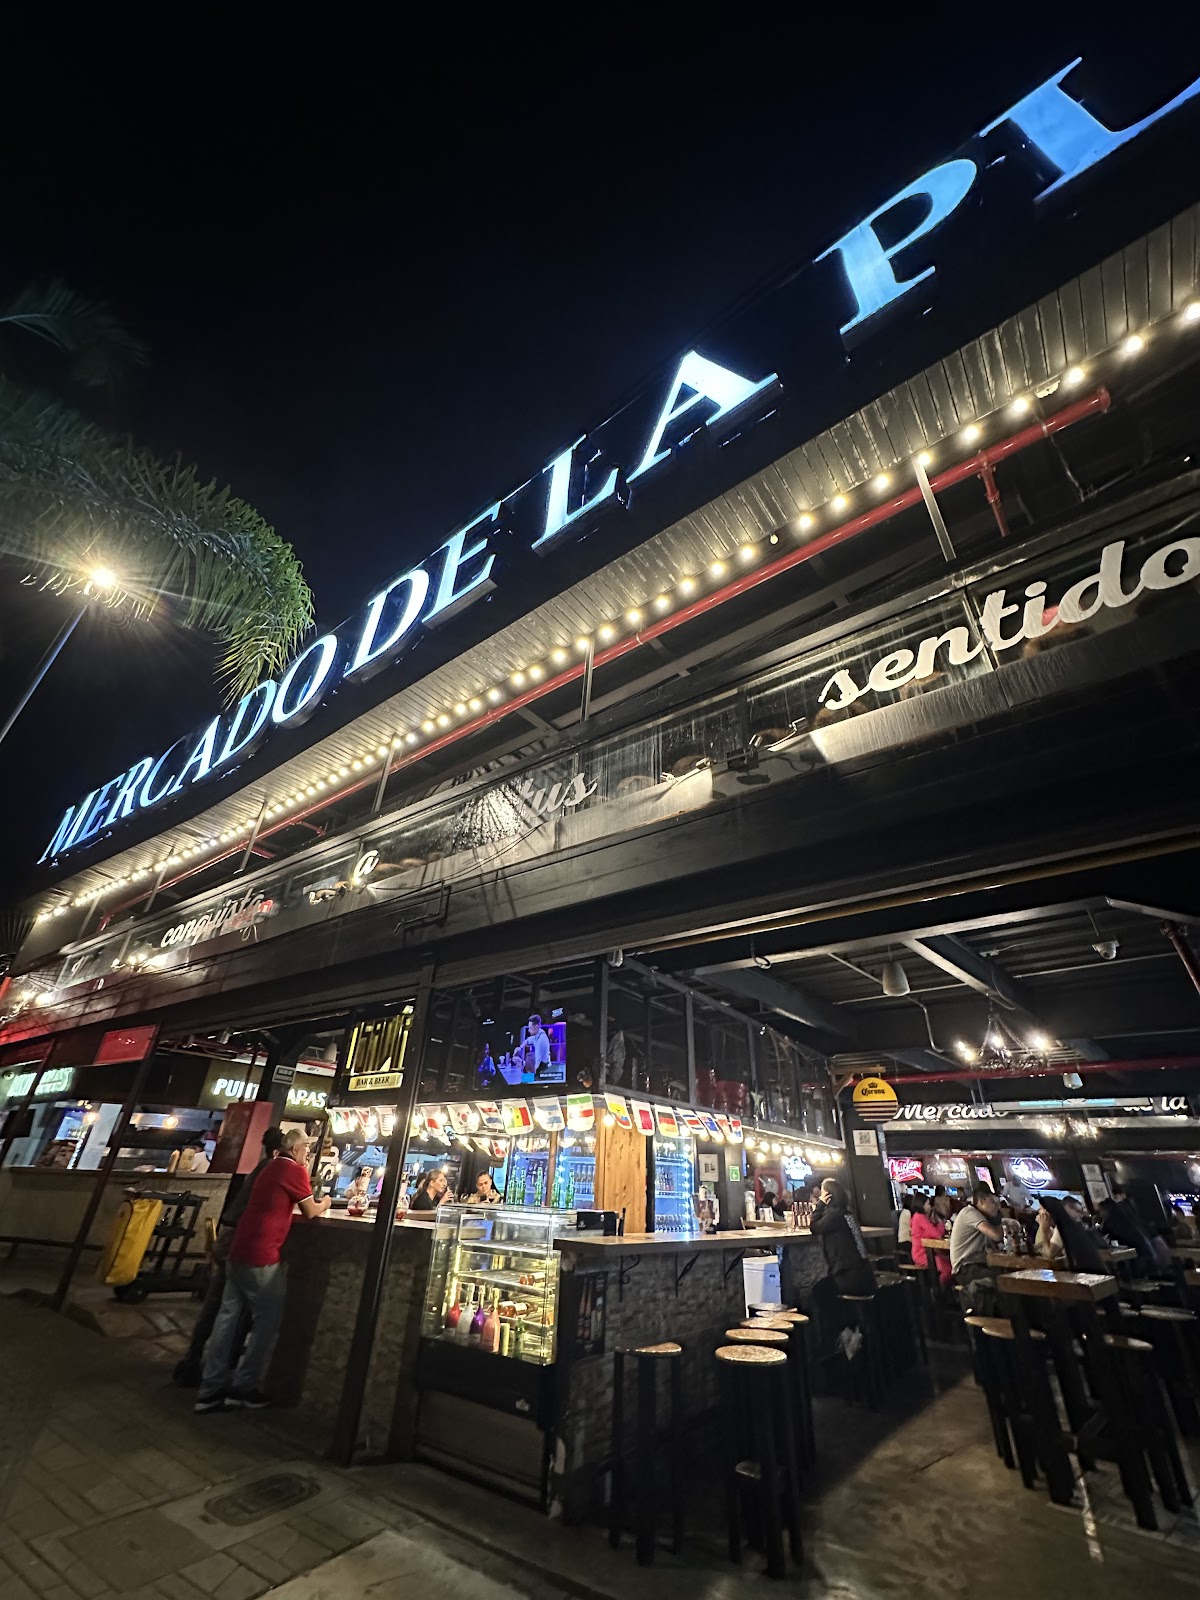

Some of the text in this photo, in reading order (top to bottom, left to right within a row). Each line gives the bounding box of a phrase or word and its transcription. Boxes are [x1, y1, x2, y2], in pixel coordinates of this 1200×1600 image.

[36, 634, 338, 865] MERCADO
[343, 500, 502, 678] DE
[531, 350, 779, 550] LA
[356, 1078, 368, 1086] BAR
[374, 1076, 390, 1085] BEER
[861, 1087, 886, 1097] Corona
